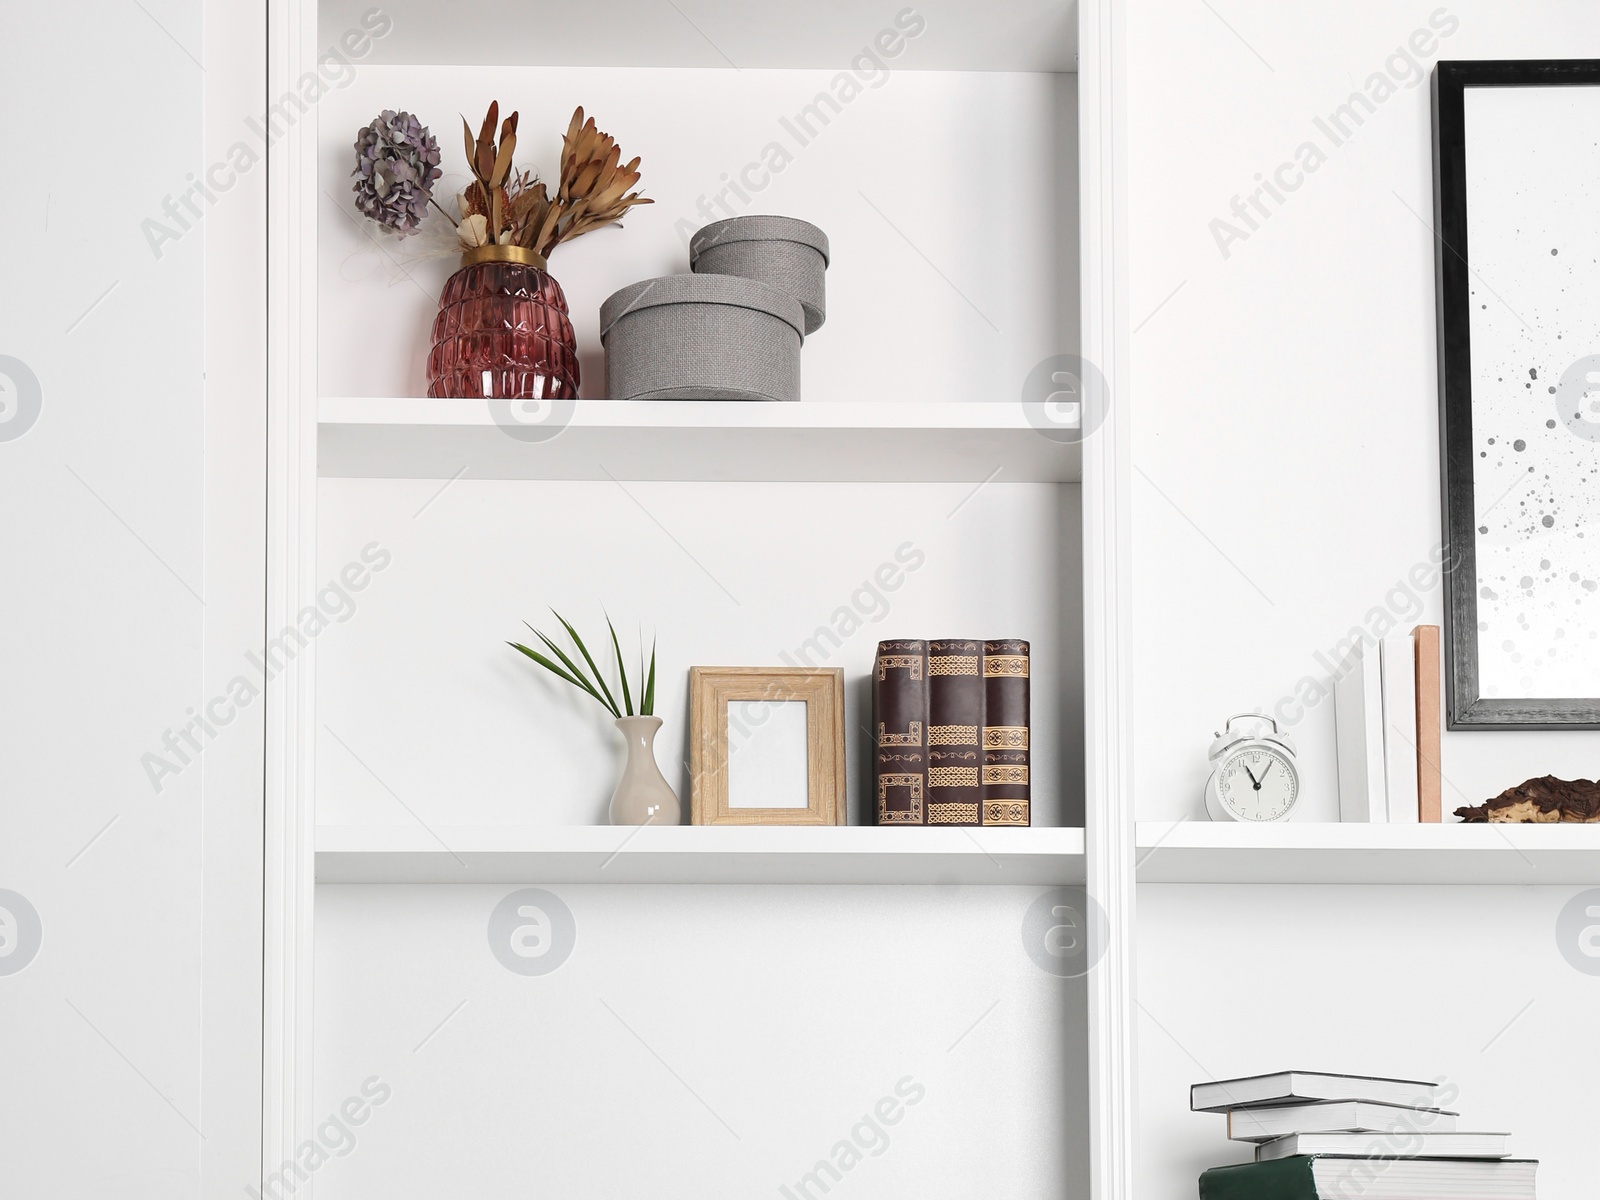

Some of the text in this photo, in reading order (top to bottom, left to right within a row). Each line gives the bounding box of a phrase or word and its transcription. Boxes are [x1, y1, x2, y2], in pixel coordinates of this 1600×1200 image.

[1252, 754, 1261, 763] 12
[1228, 769, 1236, 778] 10
[1279, 769, 1285, 778] 2
[1224, 783, 1231, 792] 9
[1284, 783, 1290, 792] 3
[1229, 797, 1236, 806] 8
[1280, 797, 1286, 806] 4
[1240, 807, 1247, 816] 7
[1255, 812, 1262, 820] 6
[1271, 807, 1277, 816] 5
